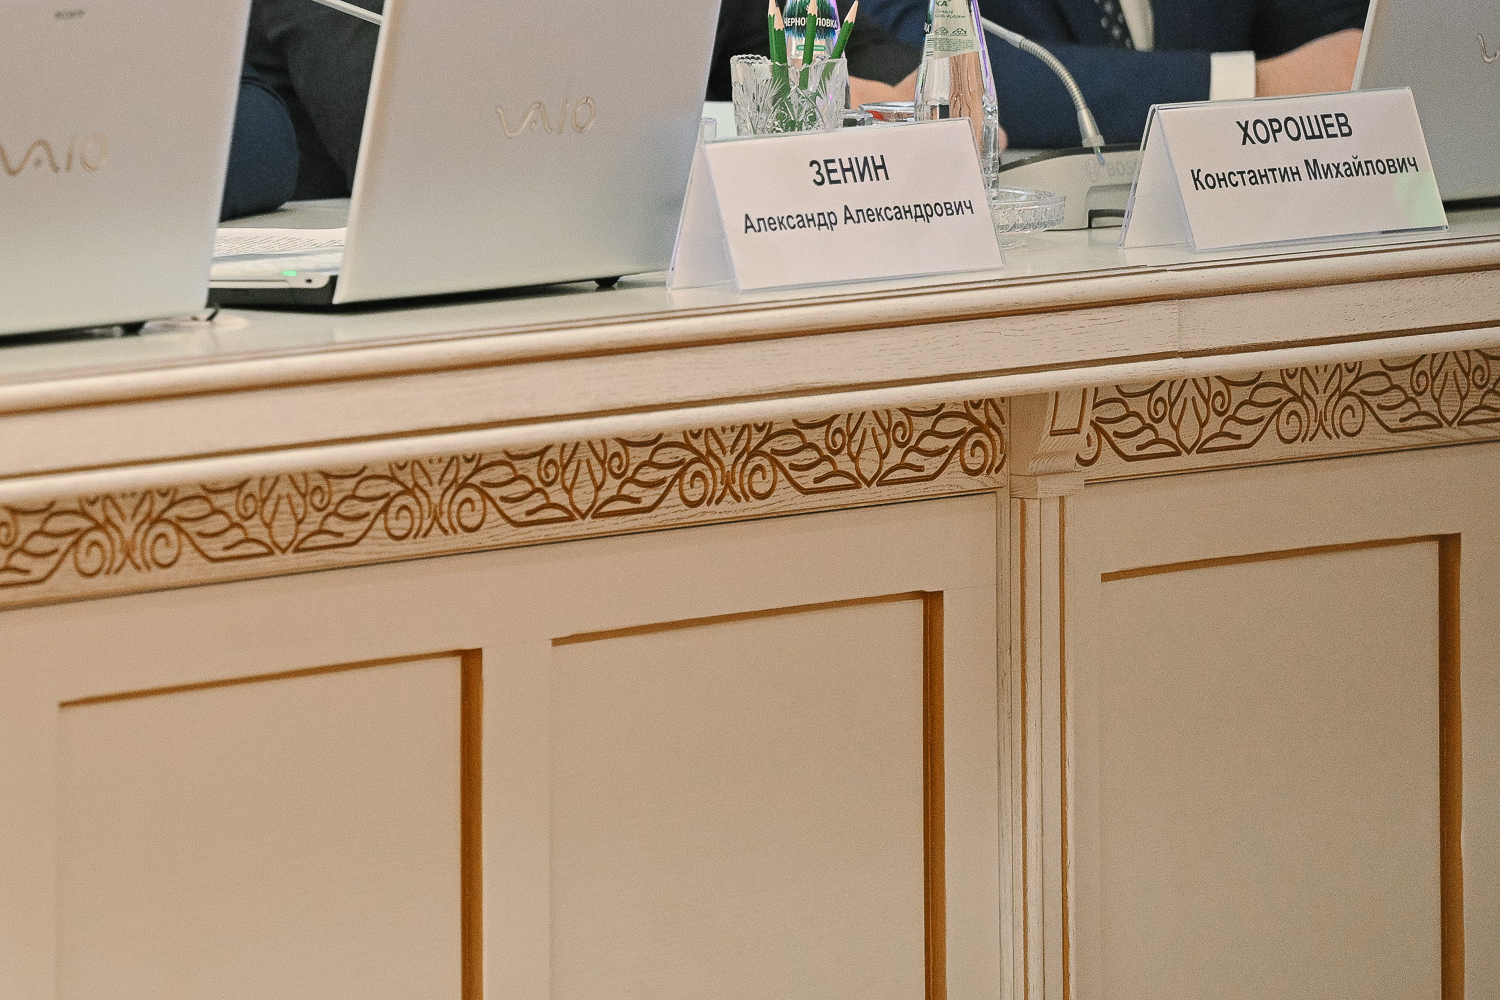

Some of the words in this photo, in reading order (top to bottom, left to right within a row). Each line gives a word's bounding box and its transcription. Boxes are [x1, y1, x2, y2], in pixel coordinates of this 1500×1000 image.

[784, 17, 838, 29] ЧЕРНОЛОВКА
[495, 96, 596, 139] VAIO
[1236, 112, 1353, 145] ХОРОШЕВ
[809, 154, 890, 187] ЗЕНИН
[1190, 165, 1303, 191] Константин
[1304, 154, 1419, 181] Михайлович
[744, 210, 838, 234] Александр
[843, 199, 975, 225] Александрович
